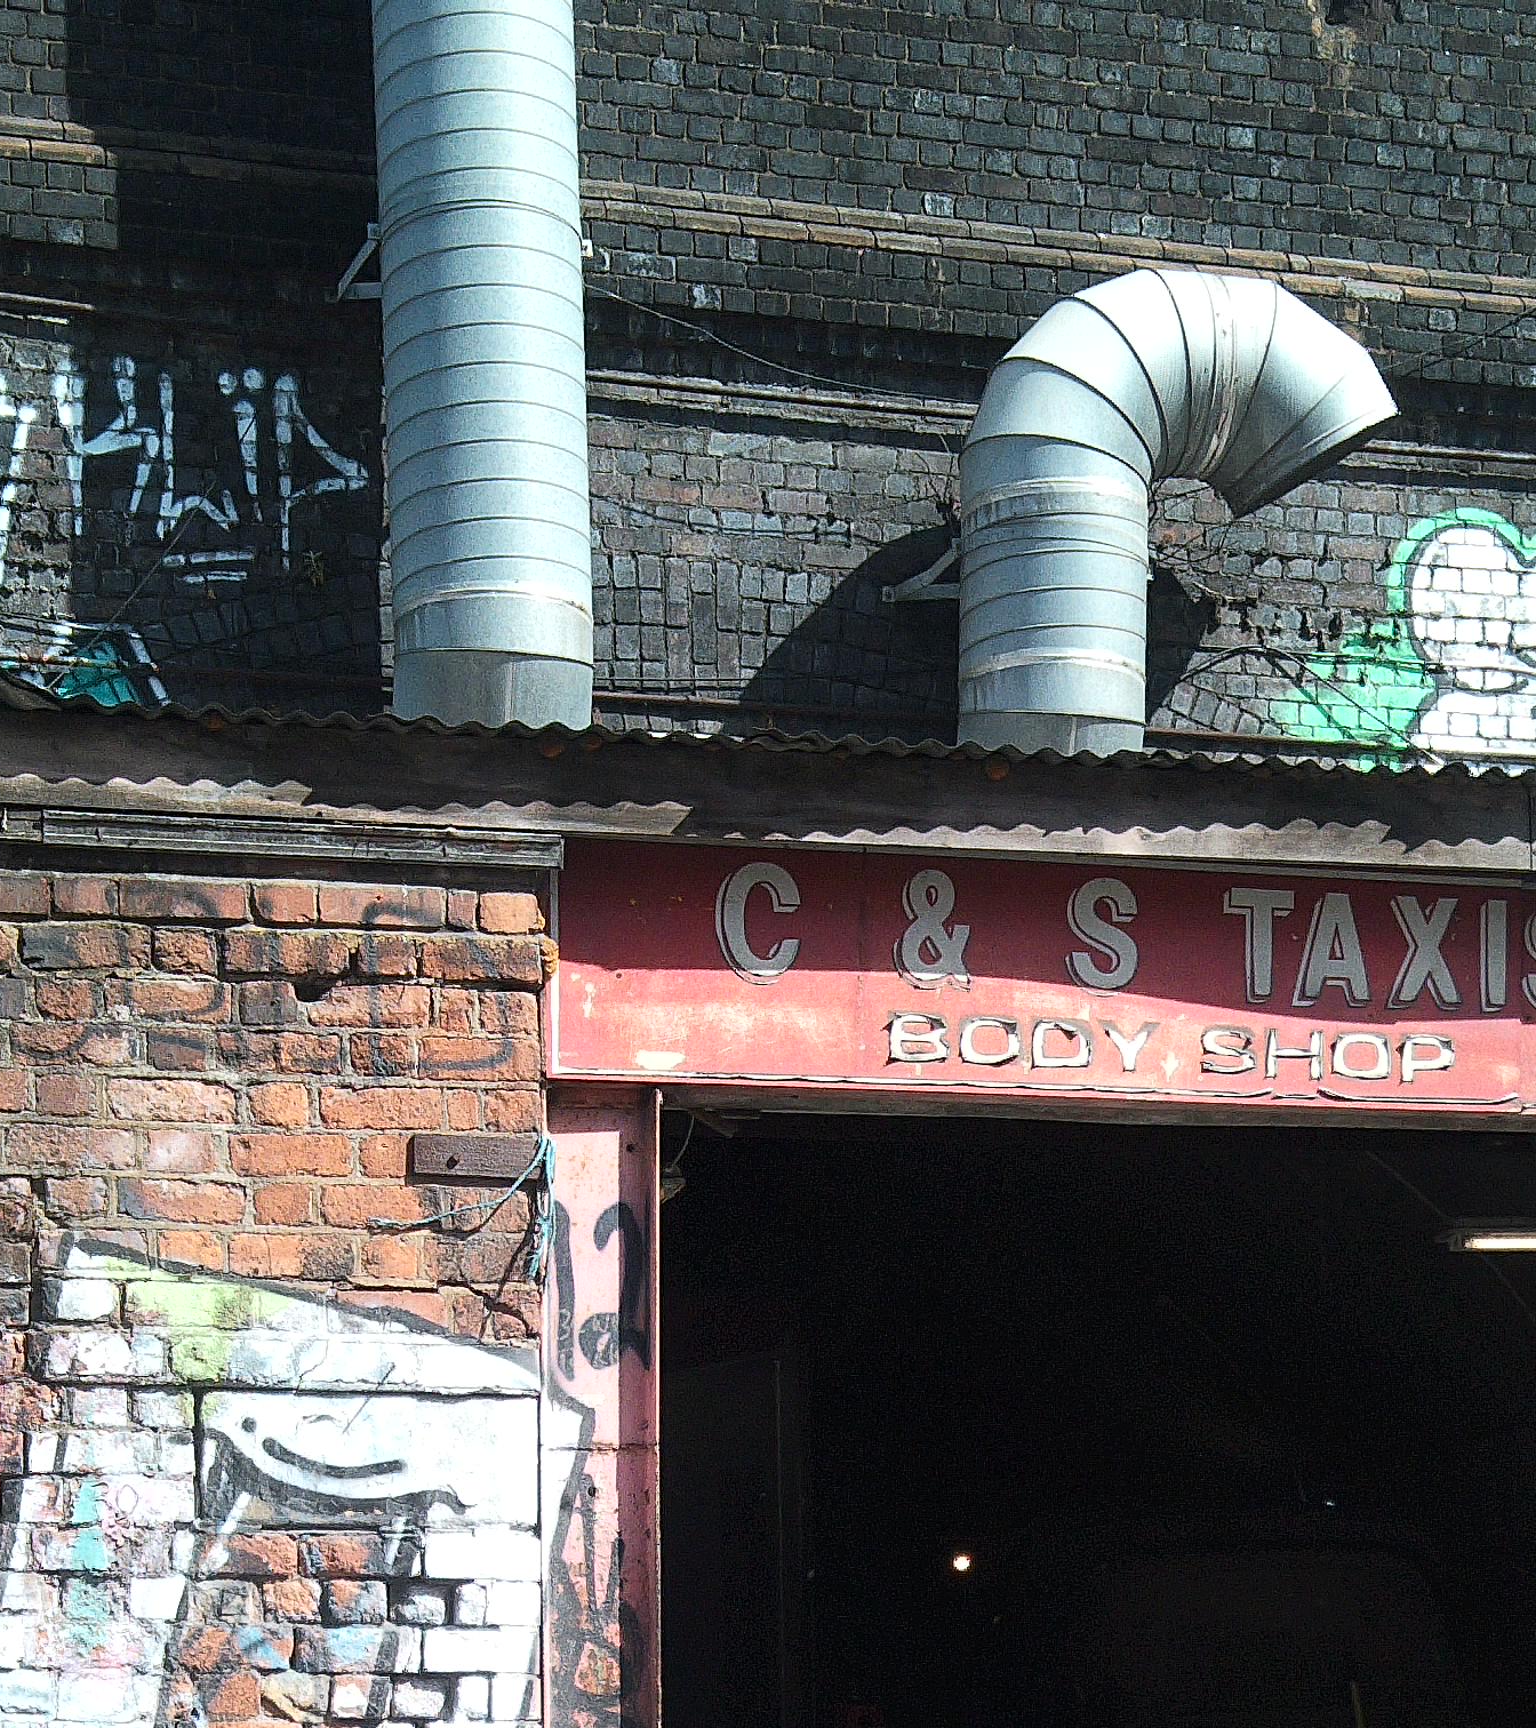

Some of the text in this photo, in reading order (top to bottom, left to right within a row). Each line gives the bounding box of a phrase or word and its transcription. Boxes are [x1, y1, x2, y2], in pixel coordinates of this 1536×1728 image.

[715, 861, 801, 986] C
[892, 869, 971, 992] &
[1065, 876, 1139, 997] S
[880, 1009, 1456, 1085] BODY SHOP
